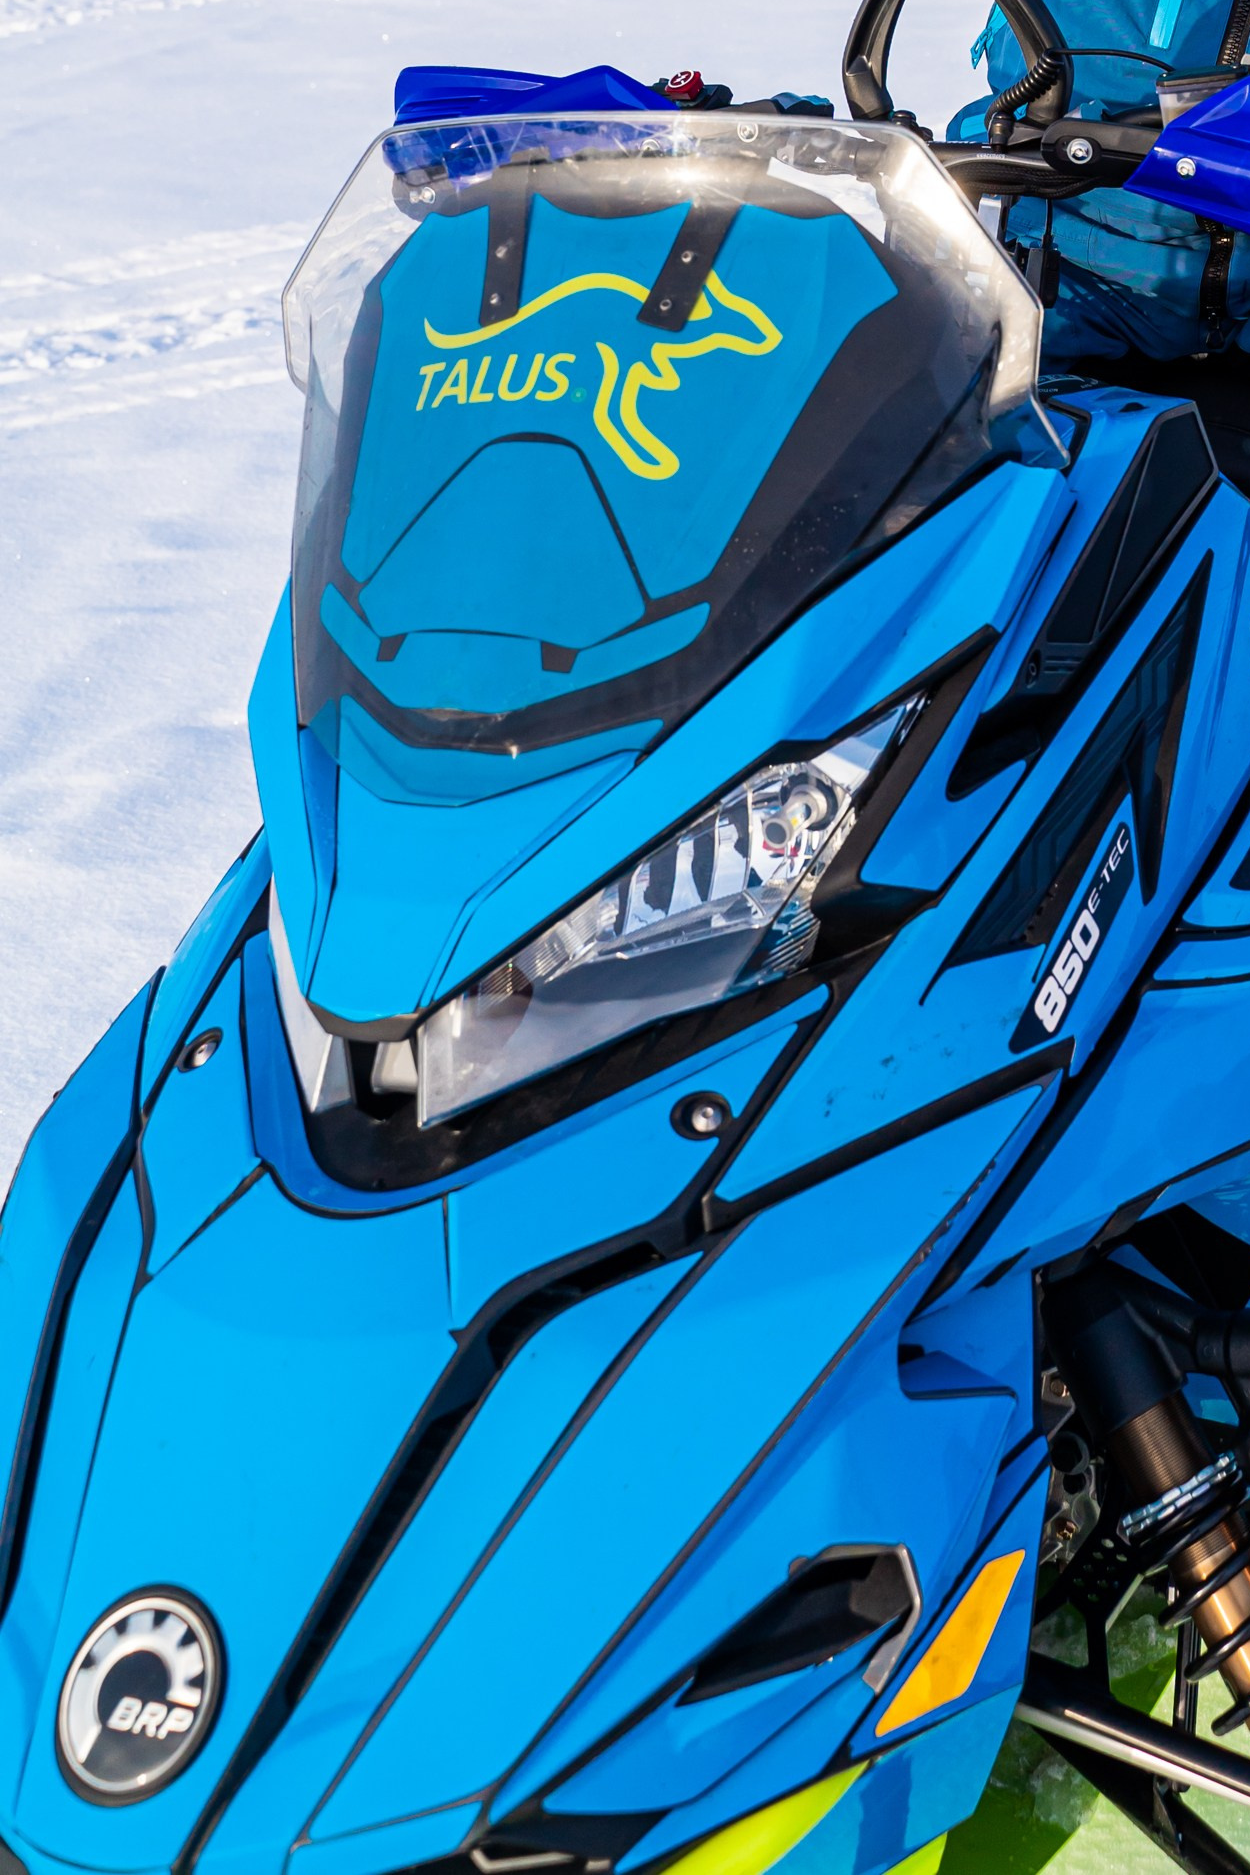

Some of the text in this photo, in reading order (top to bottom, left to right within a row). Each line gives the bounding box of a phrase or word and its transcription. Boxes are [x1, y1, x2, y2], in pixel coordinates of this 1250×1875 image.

[416, 353, 577, 412] TALUS
[1034, 828, 1129, 1033] 850 E-TEC
[107, 1696, 194, 1739] BRP
